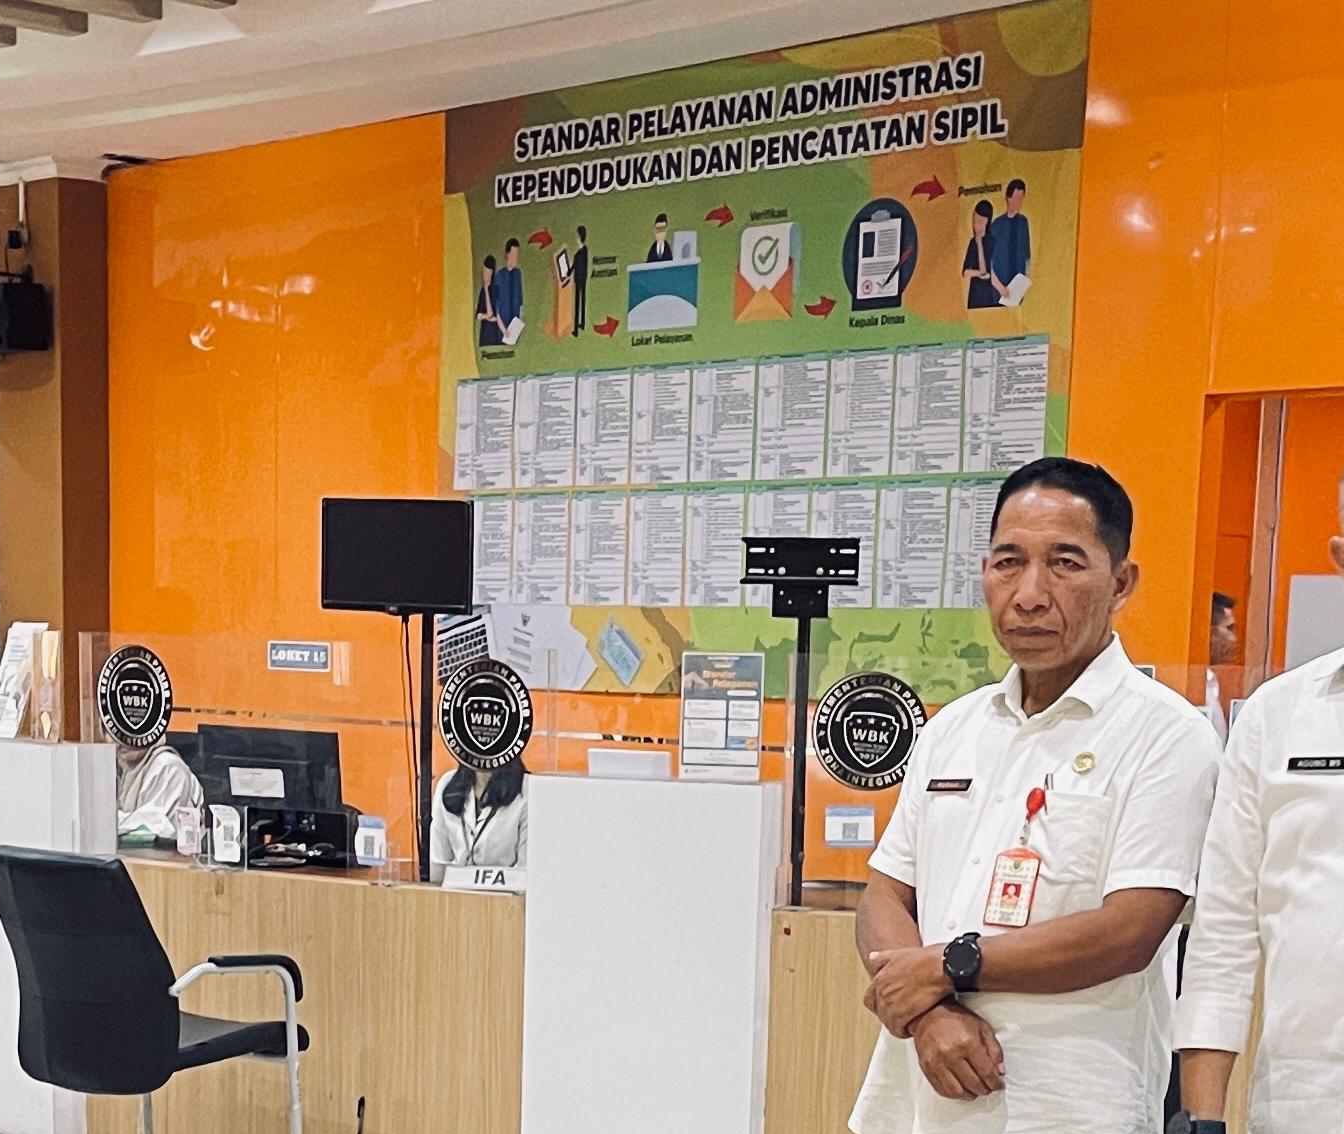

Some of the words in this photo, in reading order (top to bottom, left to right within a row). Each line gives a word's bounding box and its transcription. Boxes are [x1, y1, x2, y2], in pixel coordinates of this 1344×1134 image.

[516, 117, 621, 158] STANDAR
[628, 90, 773, 140] PELAYANAN
[780, 55, 982, 117] ADMINISTRASI
[497, 151, 682, 204] KEPENDUDUKAN
[690, 141, 742, 177] DAN
[750, 114, 925, 168] PENCATATAN
[933, 102, 1005, 142] SIPIL
[271, 650, 310, 661] LOKET
[123, 696, 148, 707] WBK
[471, 712, 501, 726] WBK
[852, 728, 889, 744] WBK
[474, 869, 506, 885] IFA
